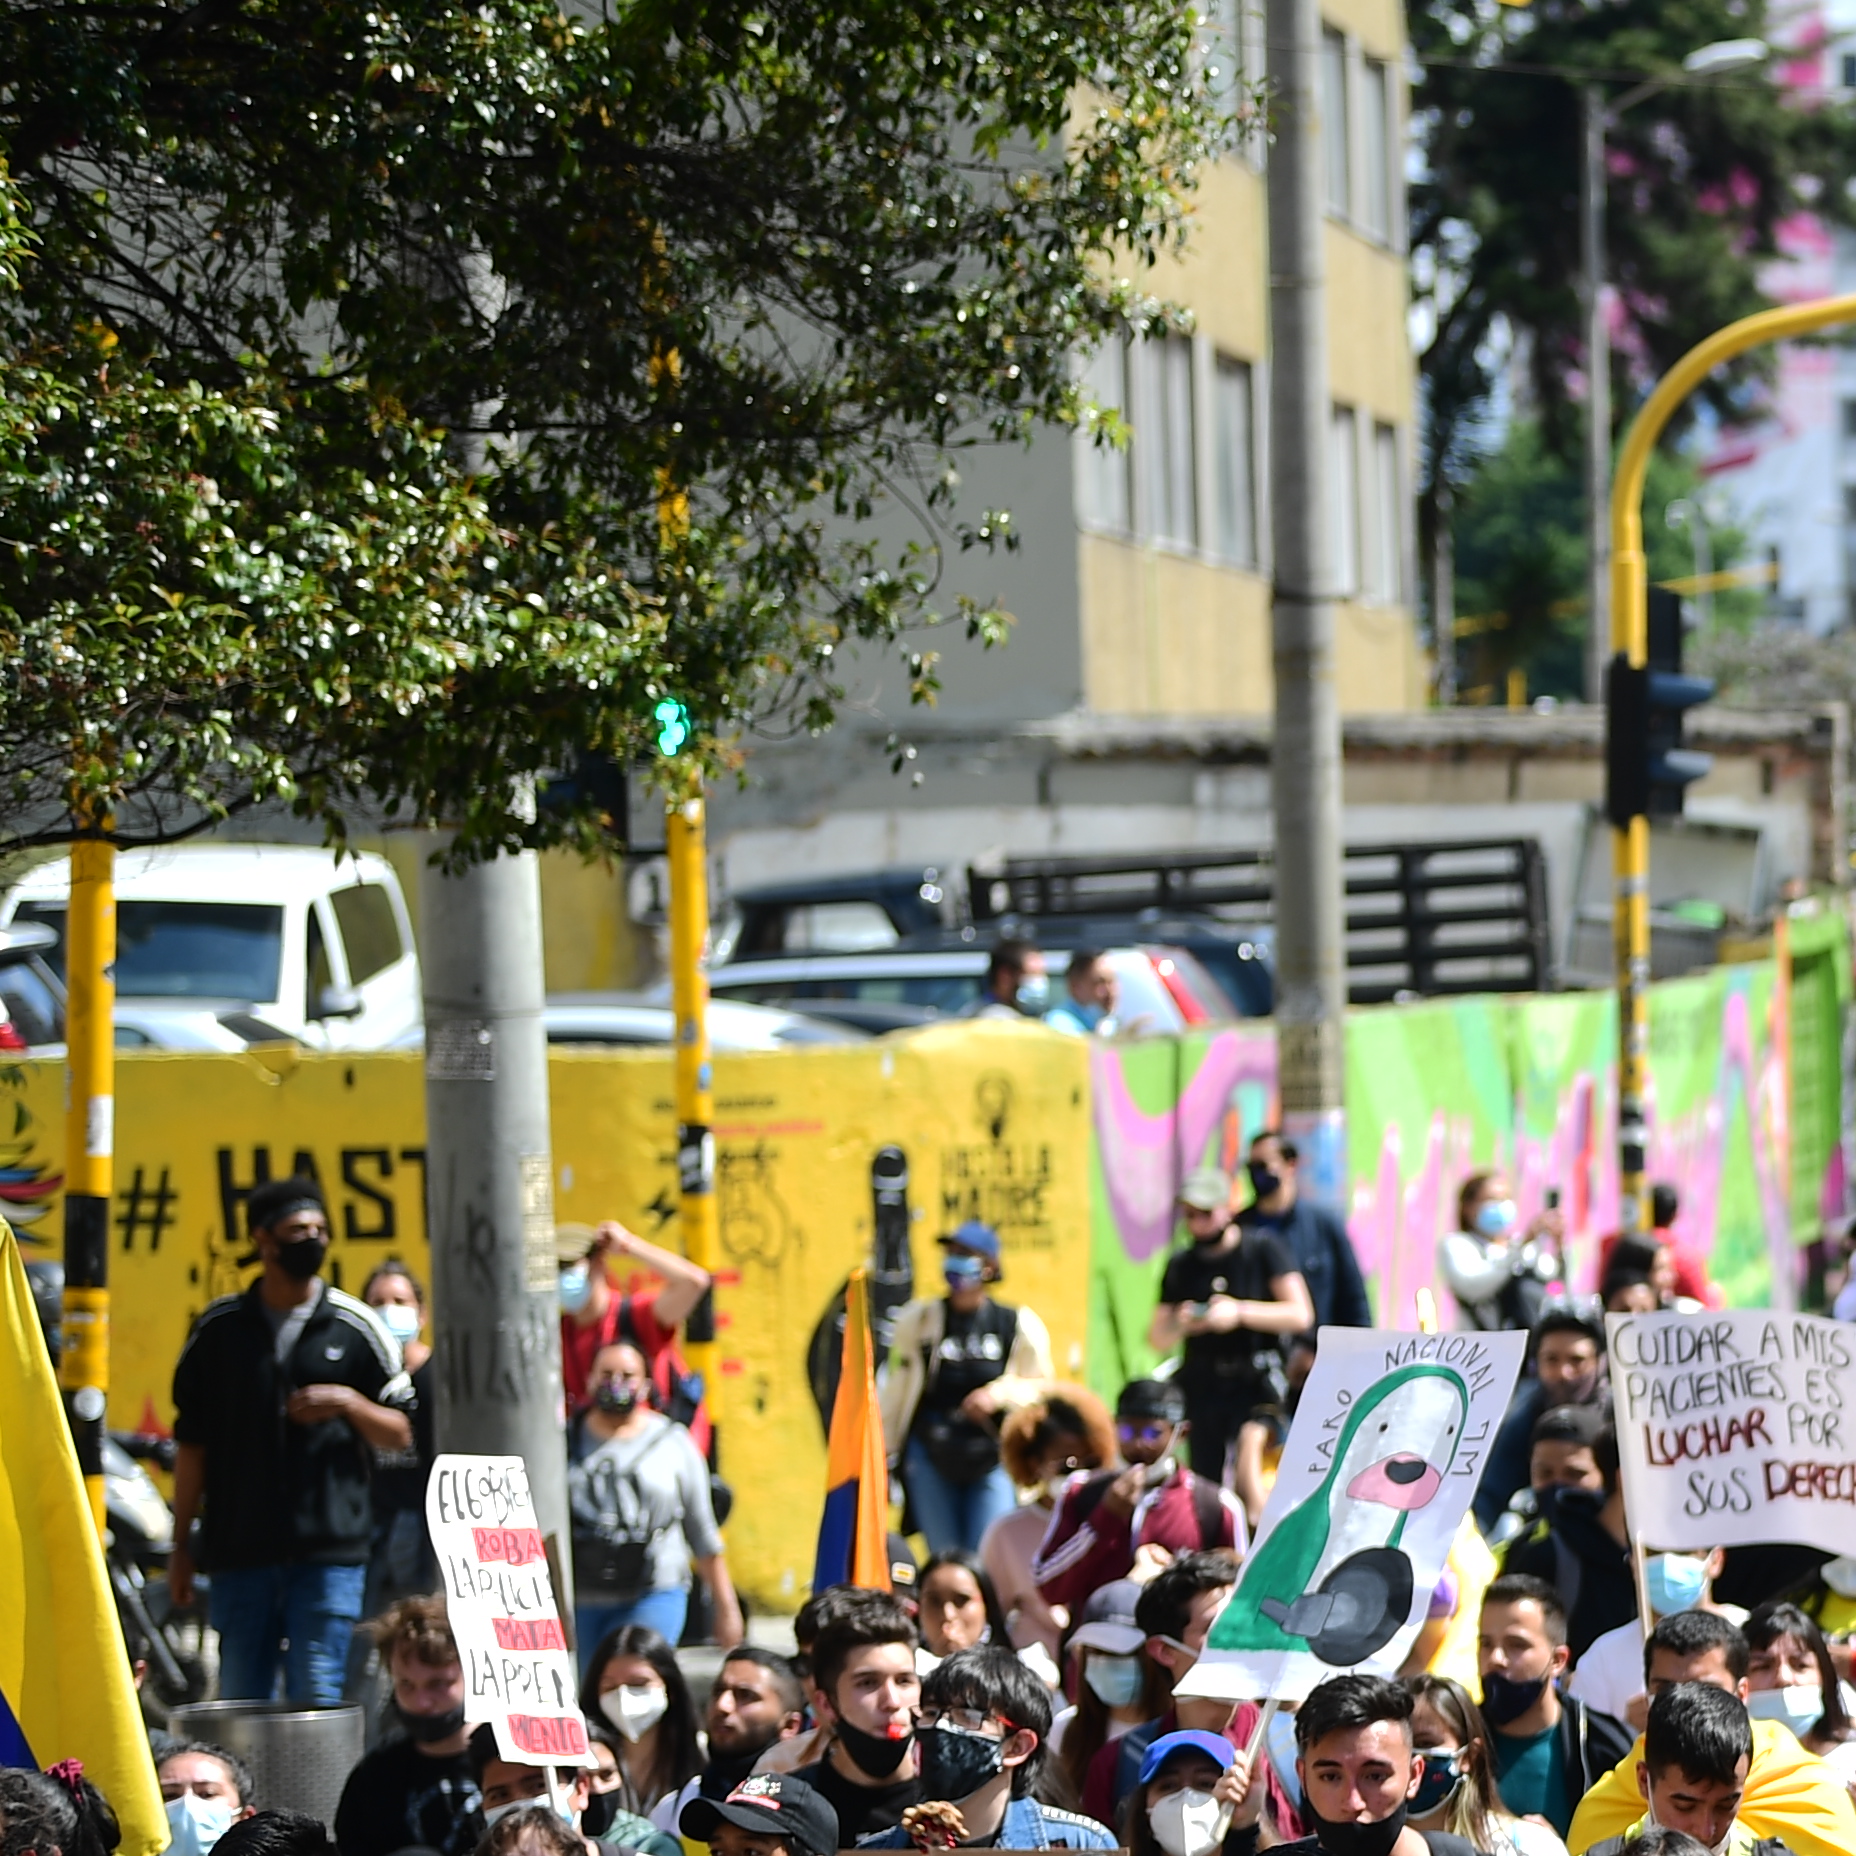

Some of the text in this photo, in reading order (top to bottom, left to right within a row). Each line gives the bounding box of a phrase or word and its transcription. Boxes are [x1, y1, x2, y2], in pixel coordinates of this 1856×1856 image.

[1613, 1320, 1851, 1370] CUIDAR A MIS
[1308, 1388, 1352, 1476] PARO
[1385, 1335, 1496, 1402] NACIONAL
[1626, 1359, 1843, 1421] PACIENTES ES
[1644, 1402, 1844, 1467] LUCHAR POR
[1683, 1465, 1753, 1518] SUS
[474, 1530, 545, 1566] ROBA
[493, 1619, 563, 1650] MATA
